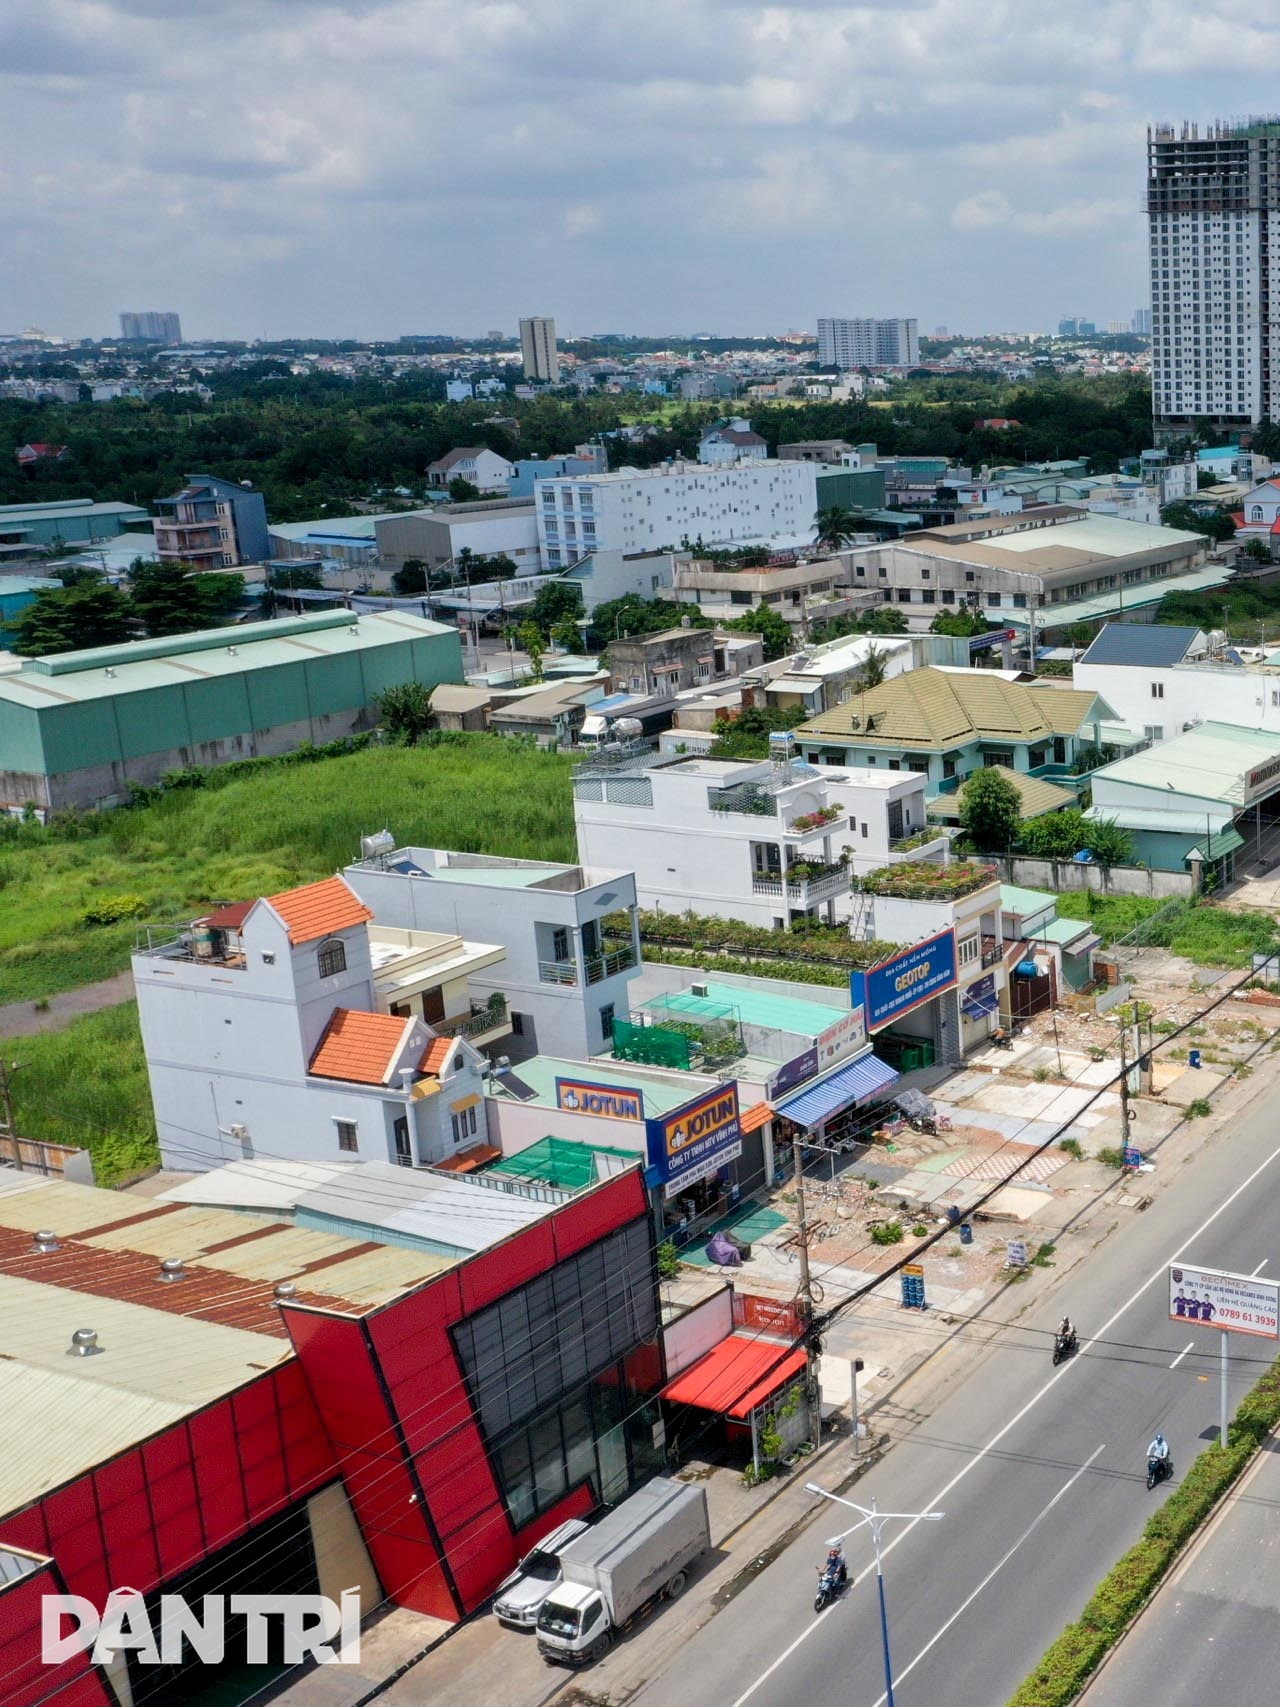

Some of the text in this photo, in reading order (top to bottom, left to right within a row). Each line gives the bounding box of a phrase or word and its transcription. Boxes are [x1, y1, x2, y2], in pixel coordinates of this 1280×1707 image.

[895, 961, 931, 993] GEOTOP
[580, 1094, 637, 1119] JOTUN
[685, 1096, 735, 1142] JOTUN
[668, 1153, 684, 1170] CÔNG
[683, 1149, 691, 1161] TY
[1216, 1296, 1277, 1314] LIÊN HỆ QUẢNG CÁO
[1219, 1307, 1276, 1327] 0789 61 3939
